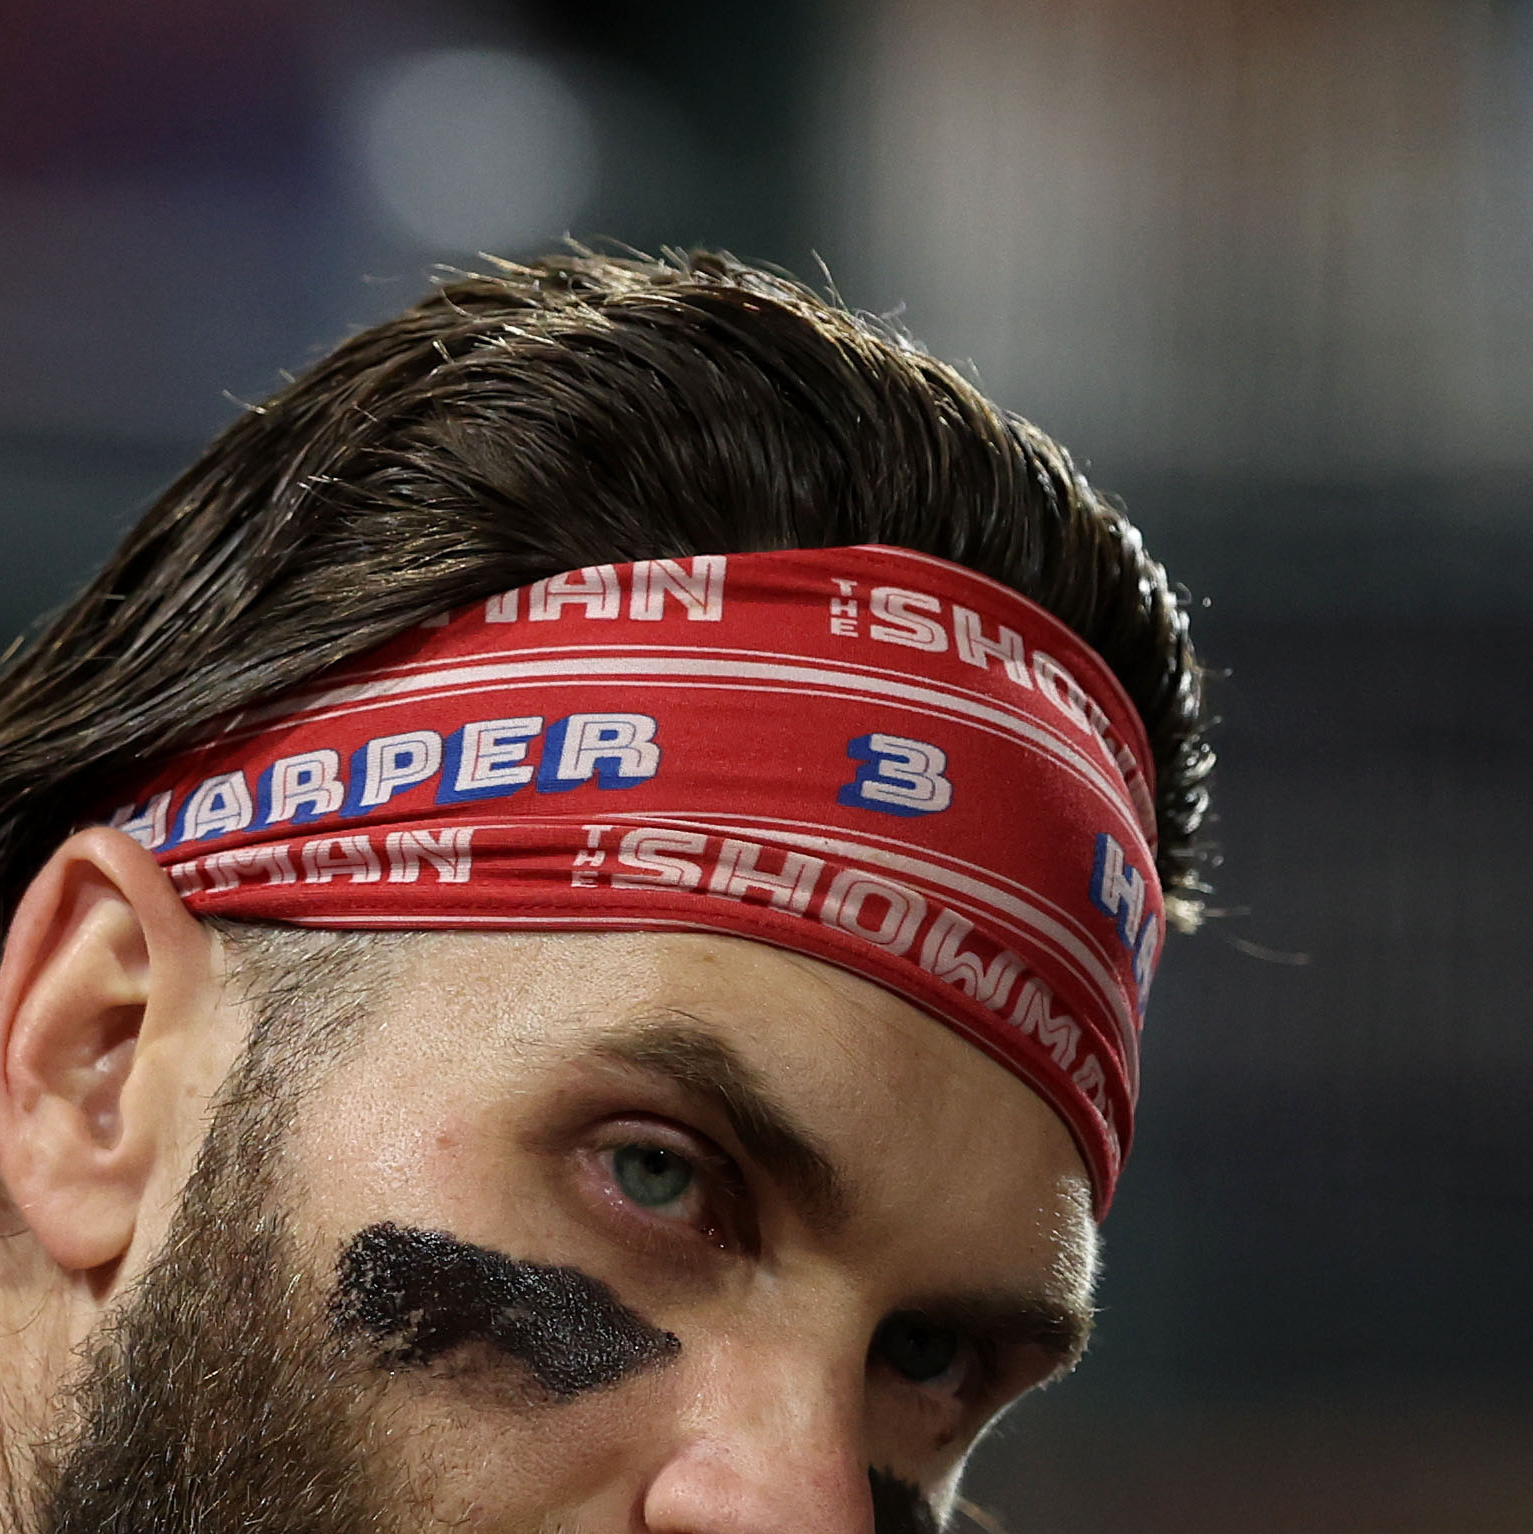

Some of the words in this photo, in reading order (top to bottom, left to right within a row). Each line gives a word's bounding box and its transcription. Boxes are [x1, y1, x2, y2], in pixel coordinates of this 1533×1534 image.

[830, 577, 859, 638] THE
[111, 711, 663, 853] HARPER
[836, 732, 954, 818] 3
[570, 824, 614, 889] THE
[611, 826, 1122, 1165] SHOWMA
